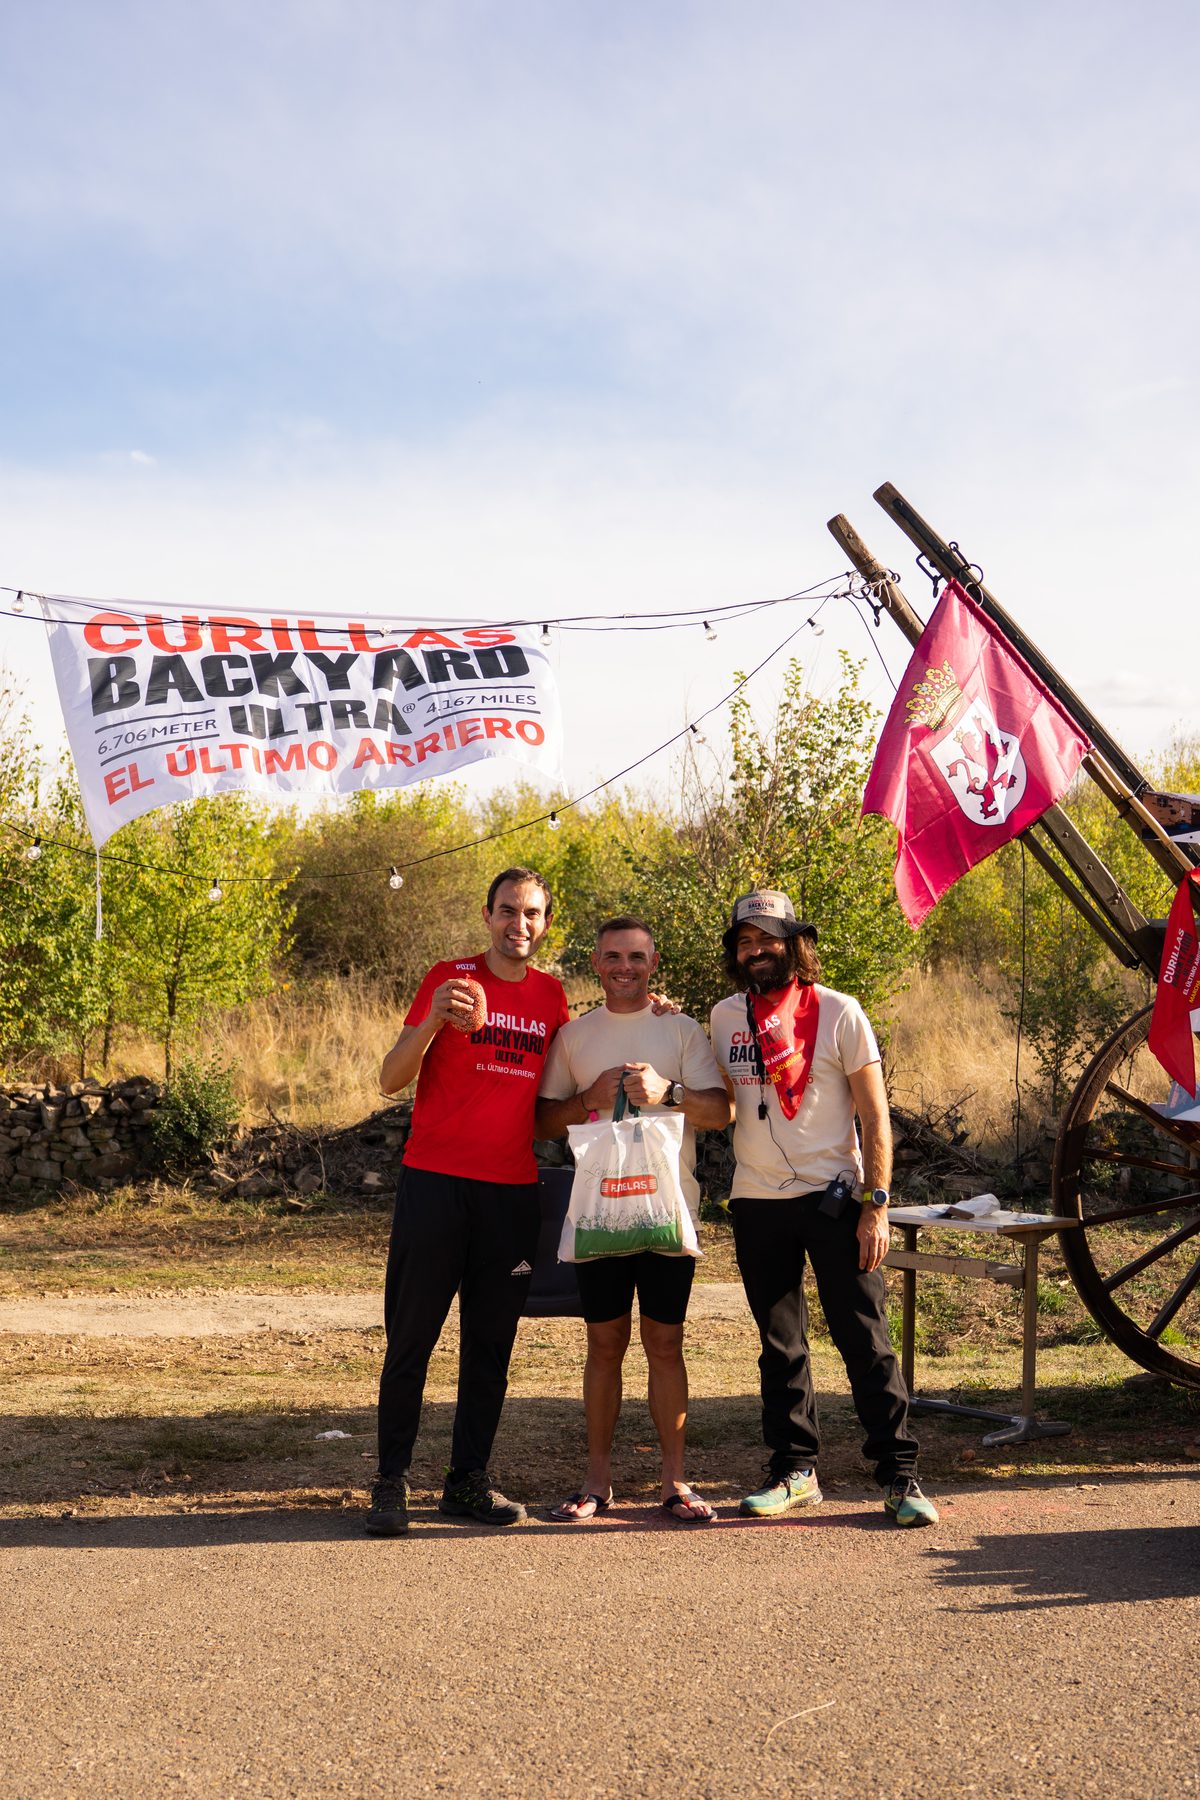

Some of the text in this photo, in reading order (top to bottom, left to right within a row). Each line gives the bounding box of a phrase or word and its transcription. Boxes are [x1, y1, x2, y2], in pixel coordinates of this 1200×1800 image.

[84, 612, 516, 654] CURILLAS
[88, 644, 530, 716] BACKYARD
[426, 694, 537, 713] 4.167 MILES
[98, 719, 217, 755] 6.706 METER
[103, 717, 545, 806] EL ÚLTIMO ARRIERO
[1163, 928, 1184, 984] CURILLAS
[485, 1012, 547, 1037] URILLAS
[470, 1027, 545, 1056] BACKYARD
[476, 1063, 486, 1071] EL
[487, 1062, 510, 1074] ÚLTIMO
[495, 1051, 523, 1065] ULTRA
